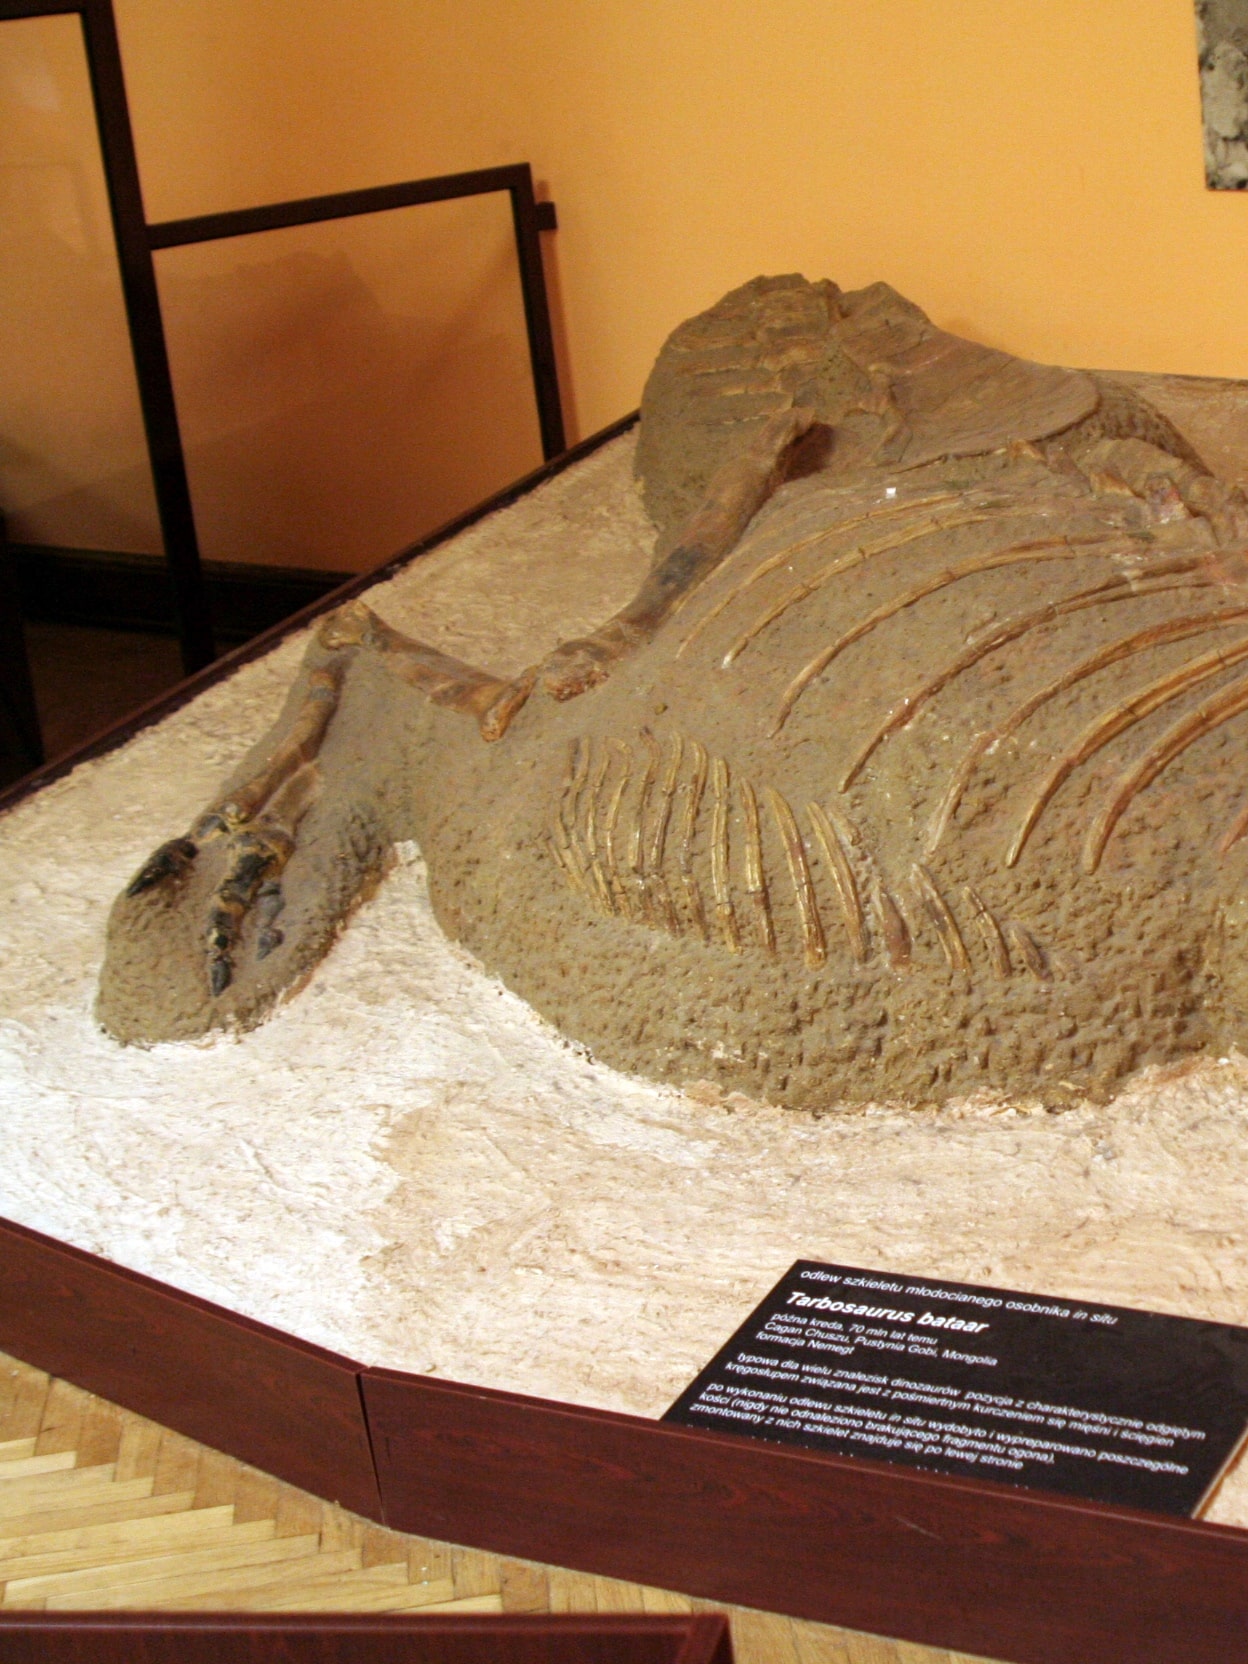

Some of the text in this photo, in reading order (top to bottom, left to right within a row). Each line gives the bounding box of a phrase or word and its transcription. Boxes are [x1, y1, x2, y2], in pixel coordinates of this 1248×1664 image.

[785, 1291, 990, 1334] Tarbosaurus bataar
[800, 1270, 1119, 1326] odlew szkieletu młodocianego osobnika in situ
[755, 1330, 856, 1356] formacja Nemegt
[764, 1322, 803, 1336] Cagan
[854, 1335, 906, 1352] Pustynia
[941, 1349, 998, 1367] Mongolia
[849, 1323, 865, 1334] 70
[866, 1327, 888, 1338] mln
[889, 1330, 907, 1341] lat
[907, 1333, 939, 1345] temu
[698, 1391, 731, 1406] kości
[731, 1397, 769, 1413] (nigdy
[769, 1405, 789, 1416] nie
[790, 1407, 864, 1429] odnaleziono
[942, 1433, 1007, 1454] fragmentu
[724, 1361, 801, 1382] kręgosłupem
[800, 1374, 857, 1392] związana
[856, 1382, 881, 1396] jest
[881, 1388, 892, 1397] z
[891, 1390, 972, 1411] pośmiertnym
[972, 1402, 1046, 1425] kurczeniem
[1046, 1416, 1067, 1430] się
[737, 1352, 1206, 1441] typowa dla wielu znalezisk dinozaurów pozycja z charakterystycznie odgiętym
[689, 1402, 1024, 1470] zmontowany z nich szkielet znajduje się po lewej stronie
[706, 1382, 724, 1393] po
[725, 1385, 788, 1404] wykonaniu
[789, 1396, 832, 1412] odlewu
[833, 1404, 888, 1422] szkieletu
[888, 1412, 902, 1423] in
[902, 1415, 927, 1427] situ
[996, 1432, 1097, 1459] wypreparowano
[1097, 1450, 1190, 1476] poszczególne
